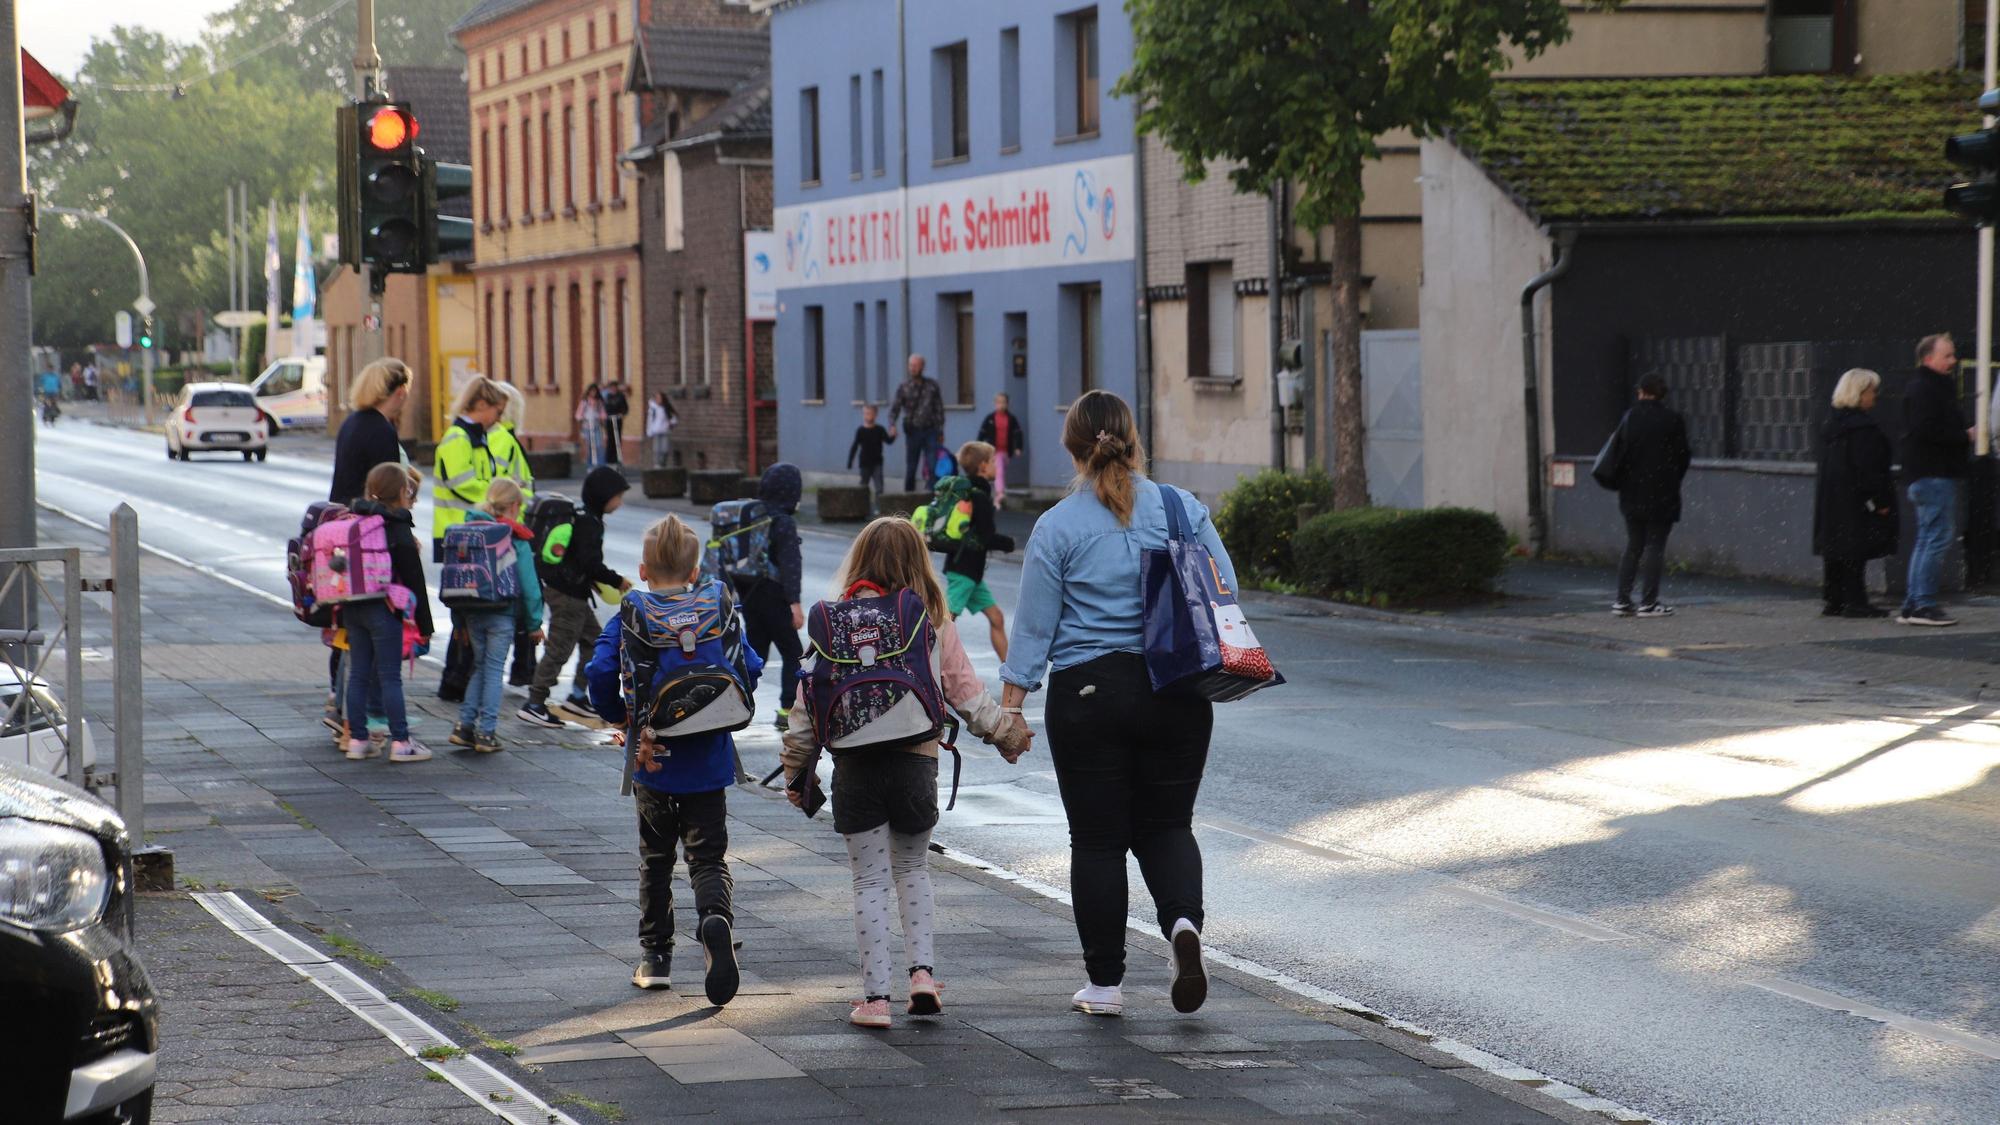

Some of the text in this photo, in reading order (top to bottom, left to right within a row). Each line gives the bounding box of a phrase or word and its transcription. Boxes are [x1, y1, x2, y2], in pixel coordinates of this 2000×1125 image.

[917, 203, 958, 256] H.G.
[964, 189, 1050, 253] Schmidt
[671, 614, 697, 625] Scout
[853, 630, 878, 642] Scout
